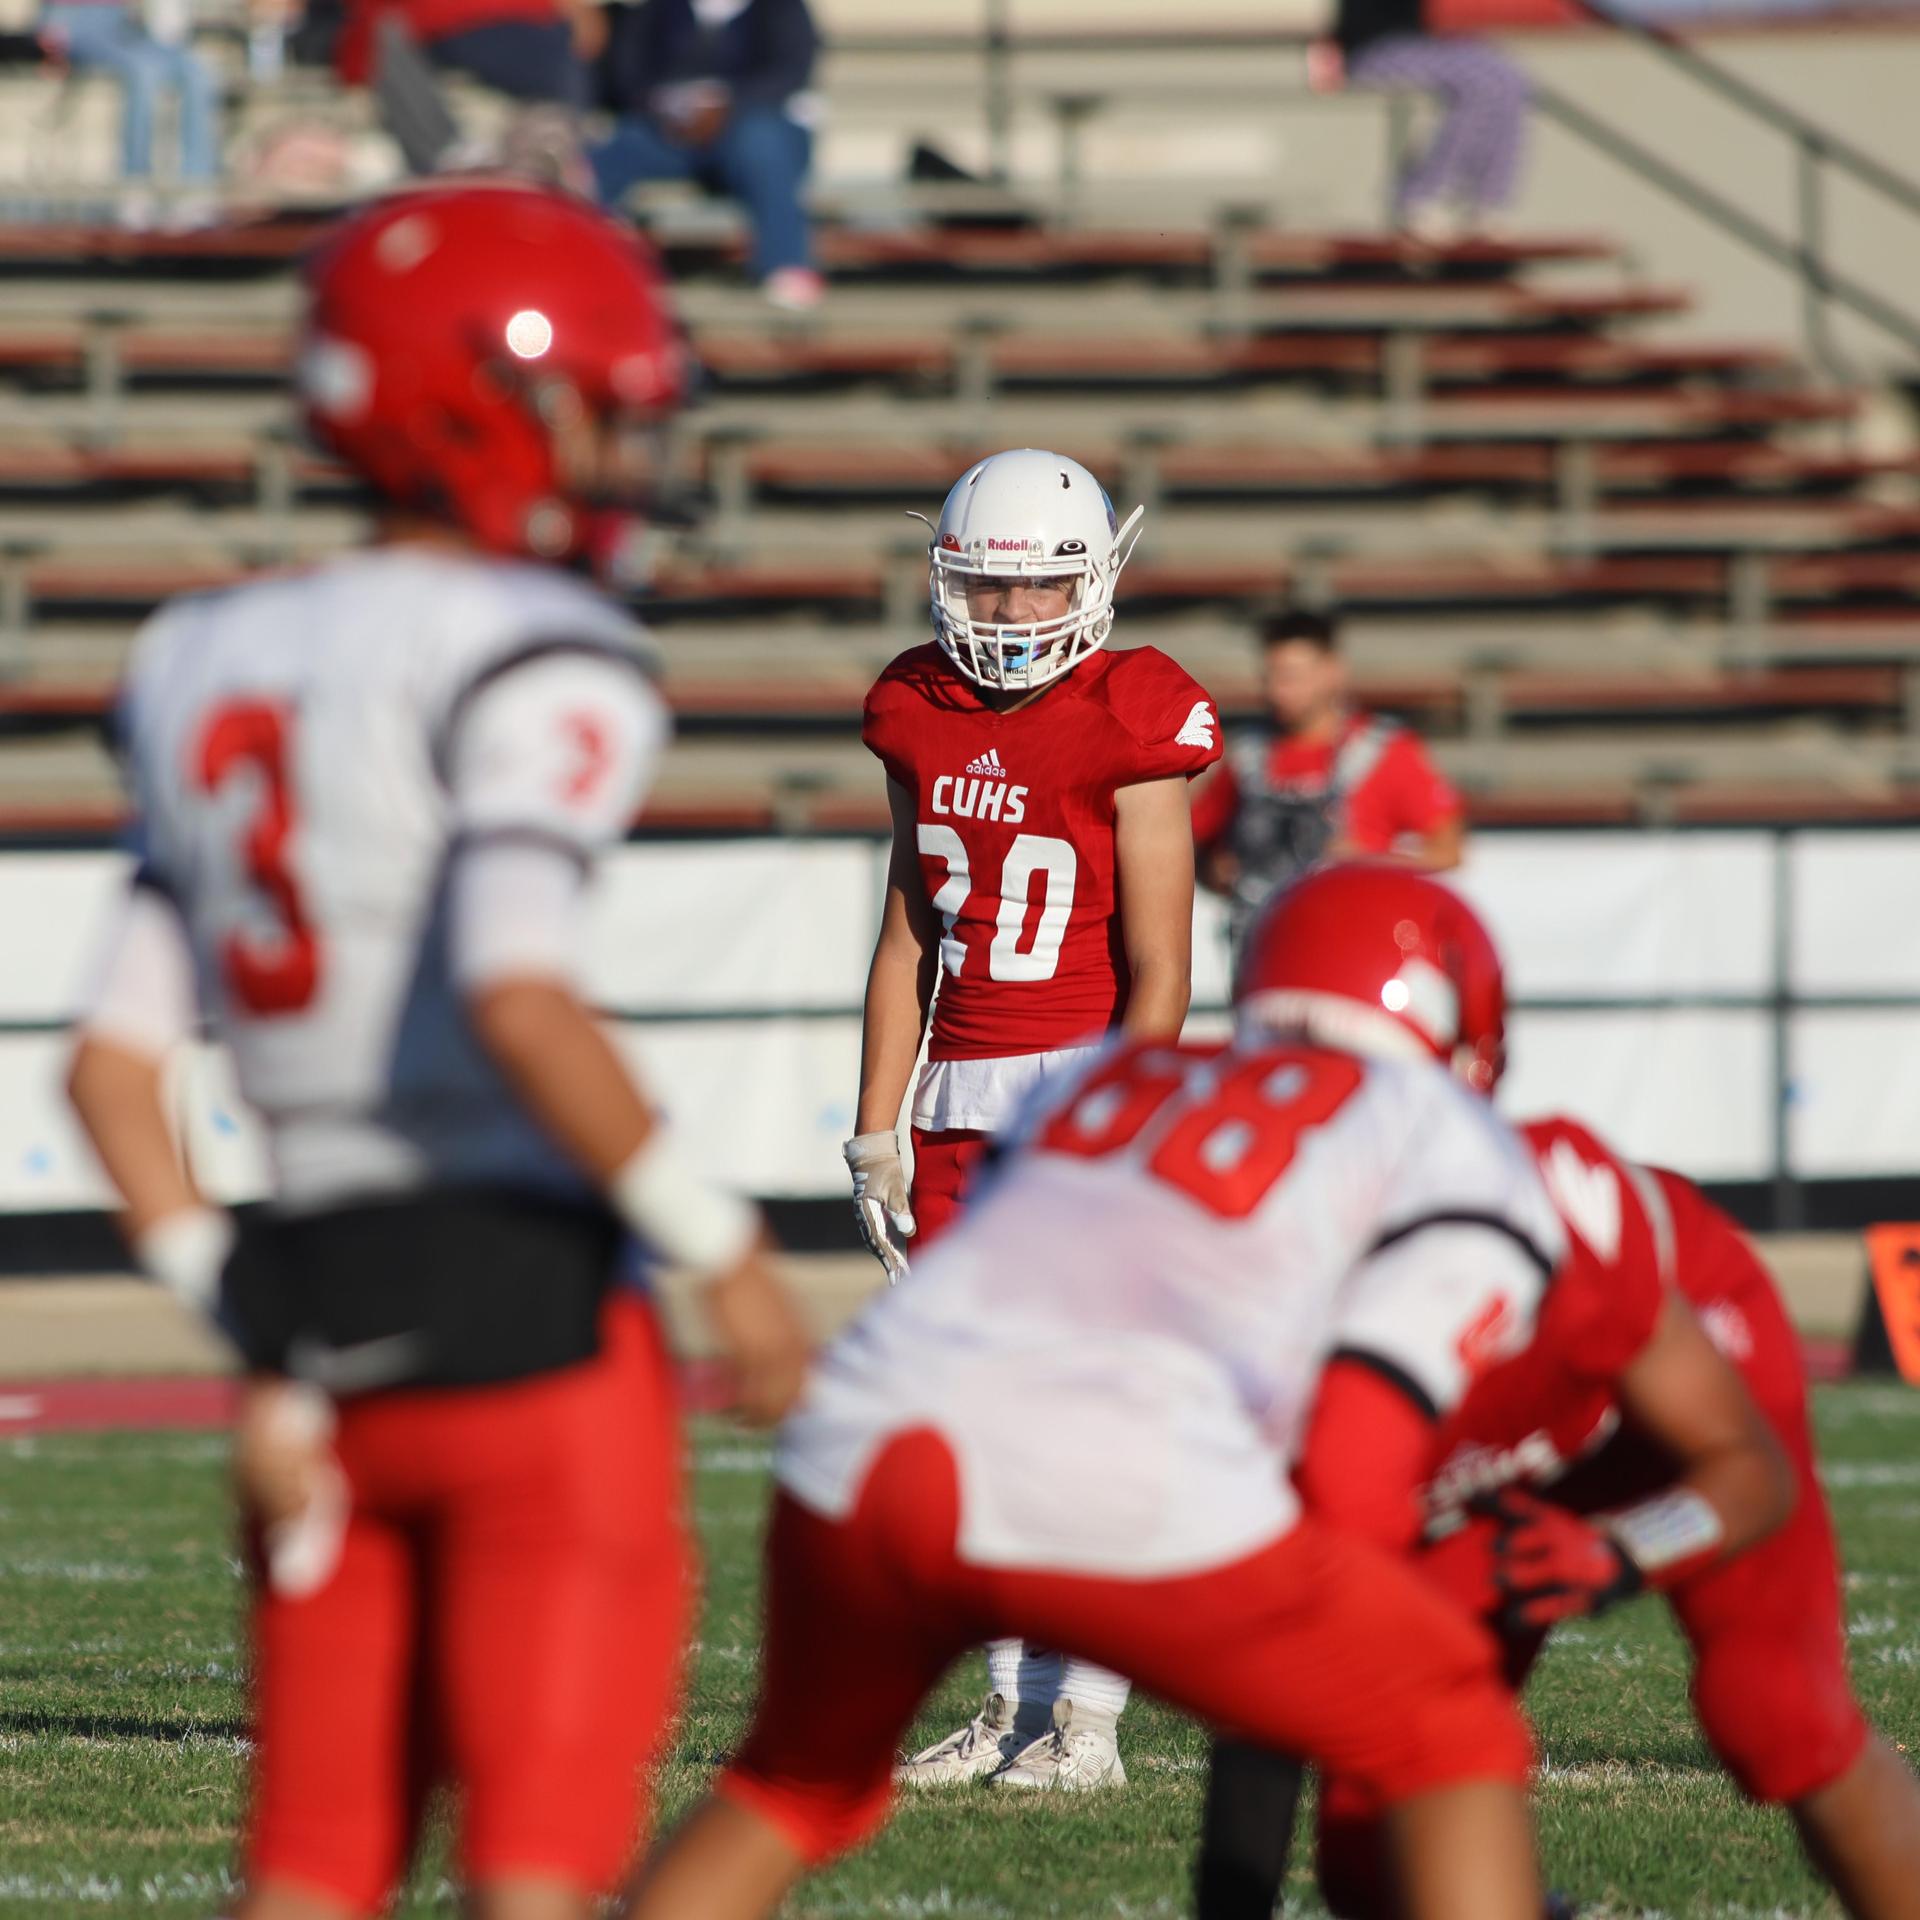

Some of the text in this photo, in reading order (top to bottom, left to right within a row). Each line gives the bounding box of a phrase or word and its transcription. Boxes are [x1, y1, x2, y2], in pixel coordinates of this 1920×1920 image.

[987, 538, 1028, 551] Riddell
[966, 763, 1006, 777] adidas
[932, 775, 1029, 823] CUHS
[191, 693, 320, 1017] 3
